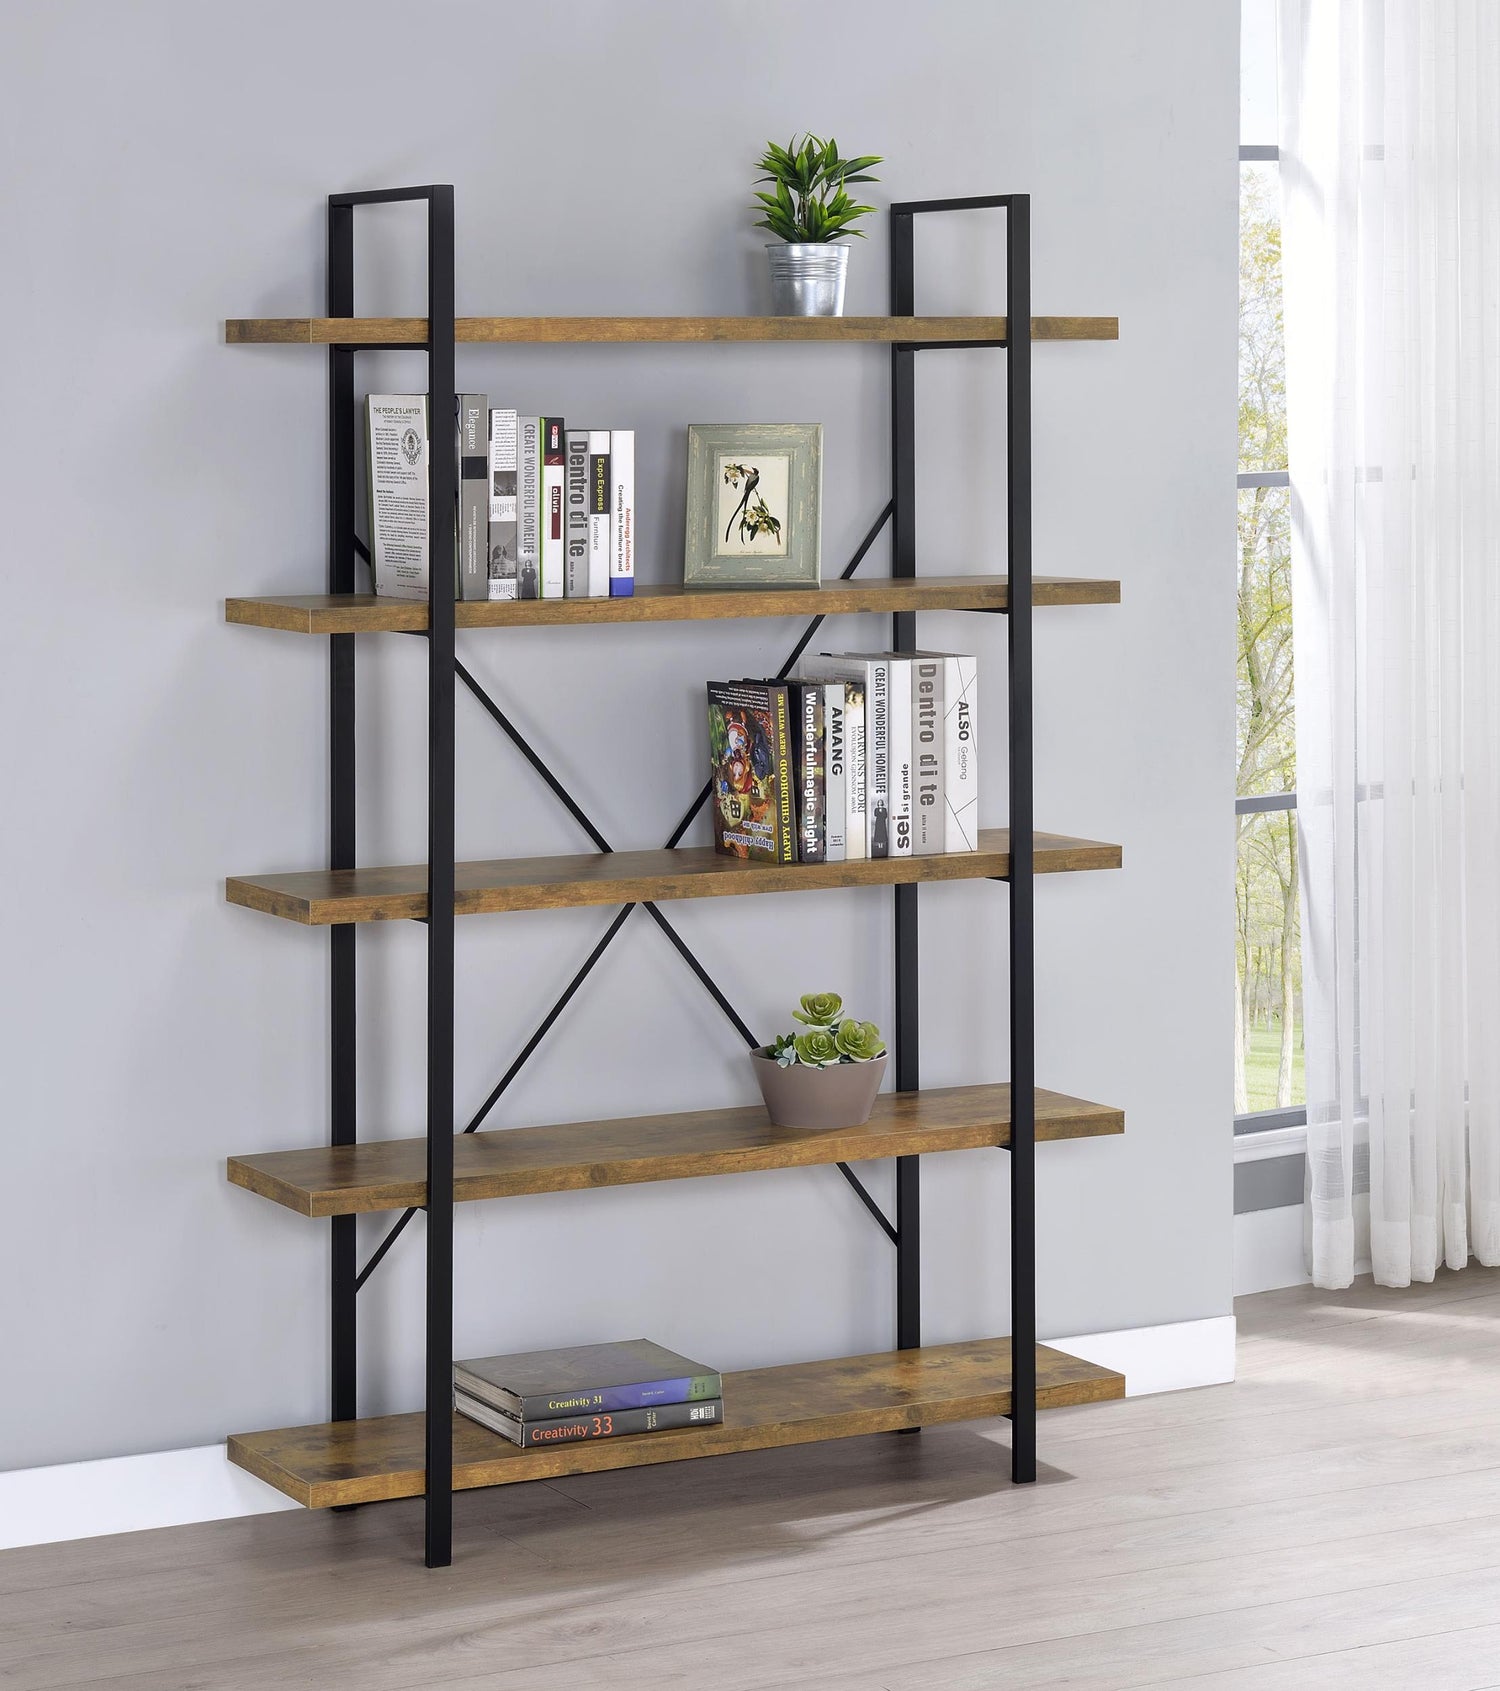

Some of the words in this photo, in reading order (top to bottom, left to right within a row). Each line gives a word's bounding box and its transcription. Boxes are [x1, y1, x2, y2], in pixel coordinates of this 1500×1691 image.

[465, 408, 480, 450] Elegance
[524, 424, 536, 454] CREATE
[524, 456, 535, 509] WONDERFUL
[570, 442, 587, 504] Dentro
[524, 512, 534, 553] HOMELIFE
[570, 511, 587, 528] di
[570, 538, 586, 556] te
[875, 668, 886, 696] CREATE
[778, 694, 784, 706] ME
[919, 664, 936, 742] Dentro
[875, 699, 886, 750] WONDERFUL
[958, 702, 969, 741] ALSO
[832, 707, 842, 776] AMANG
[876, 753, 886, 793] HOMELIFE
[920, 754, 937, 776] di
[960, 746, 968, 780] Gelang
[780, 760, 789, 823] CHILDHOOD
[901, 763, 910, 800] grande
[920, 784, 937, 806] te
[902, 803, 908, 812] si
[724, 832, 754, 846] childhood
[756, 836, 774, 851] Happy
[782, 826, 791, 861] HAPPY
[805, 815, 818, 853] night
[892, 815, 909, 848] sei
[548, 1398, 591, 1409] Creativity
[593, 1395, 602, 1404] 31
[532, 1425, 588, 1441] Creativity
[592, 1416, 613, 1436] 33
